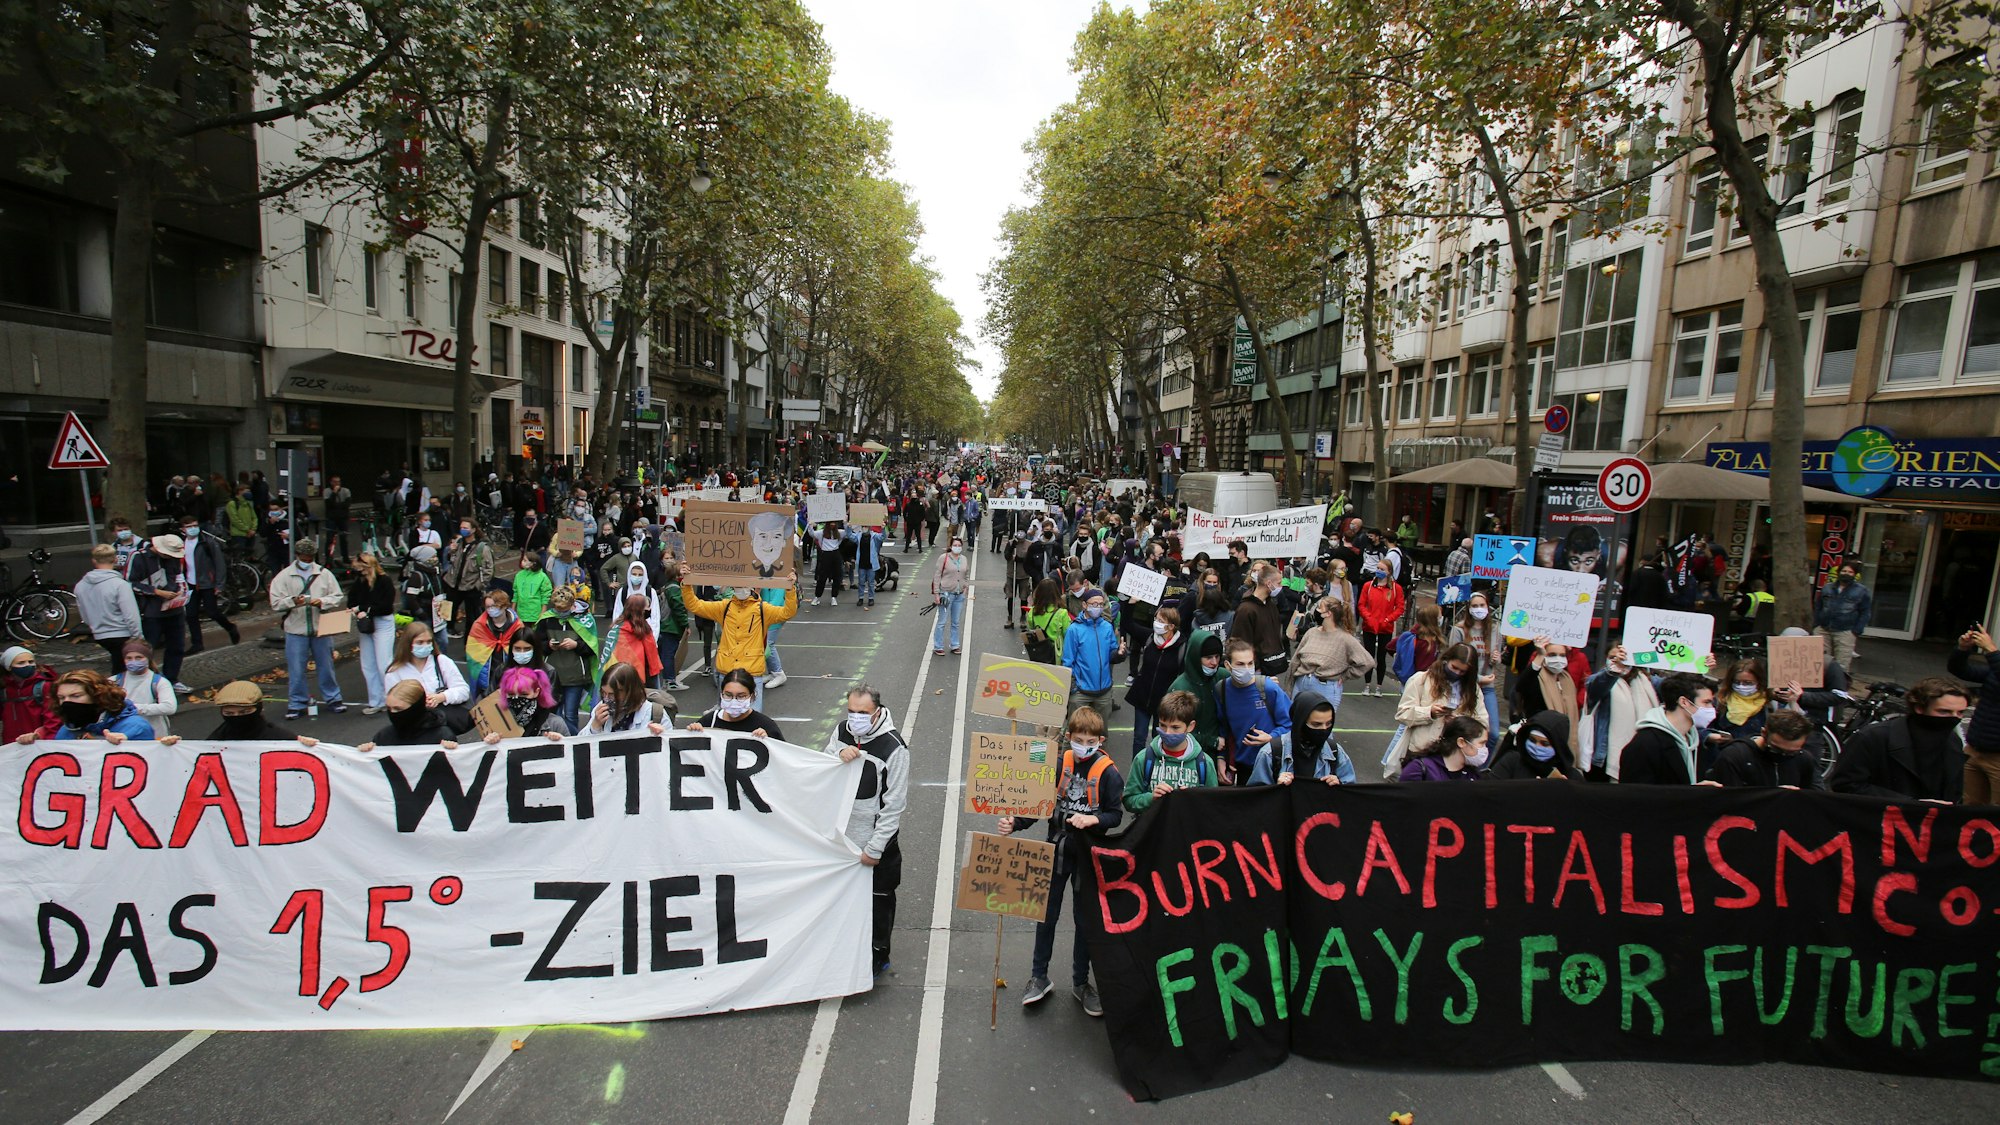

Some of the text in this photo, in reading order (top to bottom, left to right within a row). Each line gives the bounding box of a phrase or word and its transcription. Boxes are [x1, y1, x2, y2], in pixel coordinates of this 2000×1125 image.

[1711, 447, 1834, 471] PLAET
[1609, 472, 1640, 497] 30
[1548, 492, 1607, 508] mit GEH
[690, 517, 745, 536] SEI KEIN
[1193, 513, 1209, 528] Hör
[1213, 517, 1228, 528] auf
[1232, 515, 1278, 528] Ausreden
[1571, 515, 1615, 523] Studienplätz
[691, 538, 747, 559] HORST
[1478, 536, 1503, 549] TIME
[1485, 551, 1495, 561] IS
[1473, 565, 1509, 578] RUNNING
[1523, 576, 1538, 585] no
[1535, 590, 1569, 604] species
[1516, 600, 1580, 619] would destroy
[1550, 616, 1567, 627] only
[1649, 626, 1682, 643] green
[982, 679, 1063, 706] go vegan
[980, 736, 1028, 751] Das ist
[980, 753, 1013, 762] unsere
[974, 762, 1056, 786] Zukunft
[17, 736, 772, 850] GRAD WEITER
[976, 780, 1028, 797] bringt euch
[971, 797, 1055, 816] Vernunft
[978, 836, 1050, 863] the climate
[976, 864, 1000, 875] and
[1006, 870, 1028, 881] real
[977, 853, 1051, 877] crisis is here
[1090, 829, 1283, 935] BURN
[1295, 810, 1855, 917] CAPITALISM
[986, 892, 1040, 915] Earth
[1016, 883, 1047, 905] the
[38, 894, 217, 989] DAS
[269, 875, 465, 1011] 1,5°
[1520, 934, 1667, 1037] FOR
[1704, 944, 1978, 1050] FUTURE
